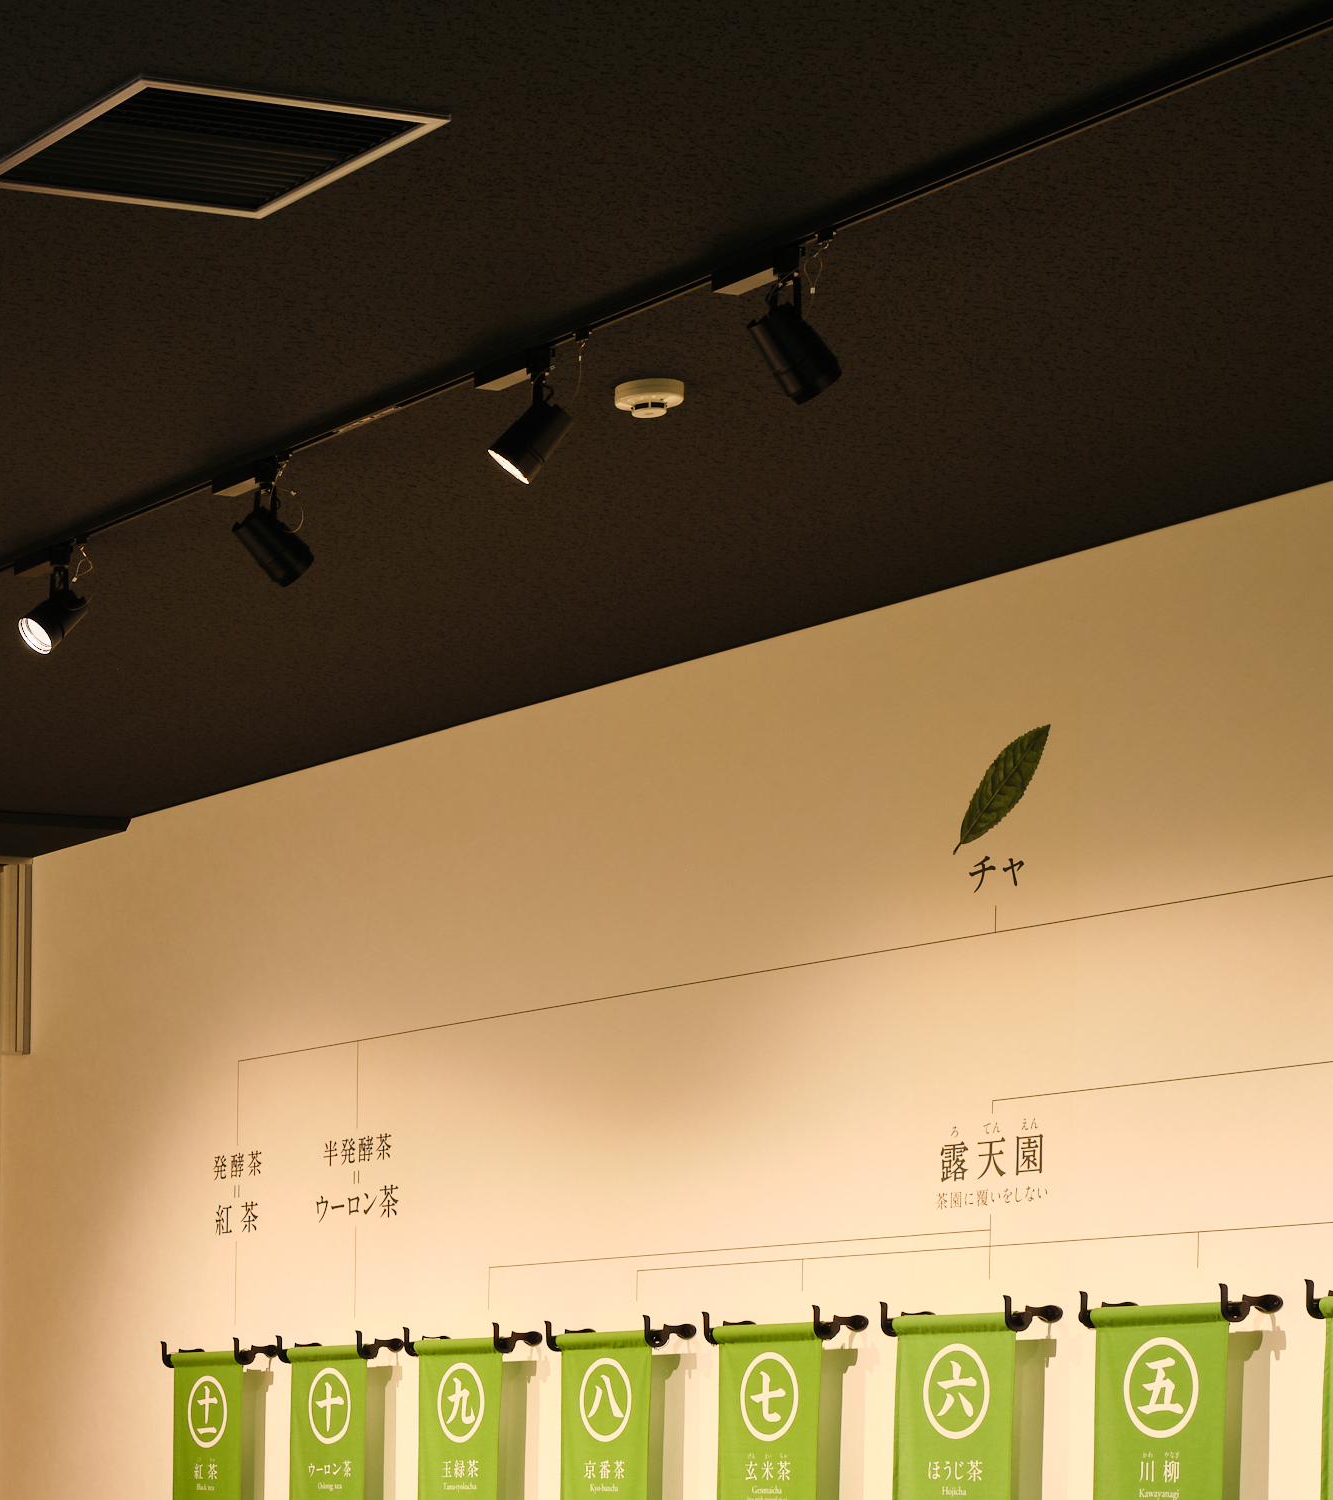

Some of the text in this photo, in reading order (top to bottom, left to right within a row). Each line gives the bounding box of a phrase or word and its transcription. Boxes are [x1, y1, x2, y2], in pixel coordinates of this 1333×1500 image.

[968, 855, 1025, 893] チャ
[983, 1121, 1001, 1135] てん
[1021, 1117, 1040, 1130] えん
[322, 1132, 393, 1168] 半発酵茶
[939, 1132, 1044, 1184] 露天園
[213, 1151, 263, 1182] 発酵茶
[315, 1184, 400, 1223] ウーロン茶
[935, 1184, 1048, 1211] 茶園に覆いをしない
[215, 1201, 259, 1236] 紅茶
[587, 1374, 624, 1418] 八
[750, 1370, 786, 1423] 七
[936, 1360, 977, 1418] 六
[1137, 1356, 1184, 1415] 五
[197, 1385, 218, 1435] 十一
[315, 1381, 345, 1432] 十
[446, 1377, 475, 1425] 九
[194, 1463, 218, 1480] 紅茶
[308, 1460, 352, 1478] ウーロン茶
[441, 1459, 479, 1479] 玉緑茶
[583, 1459, 625, 1480] 京番茶
[745, 1460, 791, 1481] 玄米茶
[928, 1460, 983, 1482] ほうじ茶
[1139, 1460, 1180, 1483] 川柳
[196, 1483, 207, 1491] Black
[589, 1483, 619, 1494] Kyo-bancha
[751, 1485, 782, 1494] Genmaicha
[941, 1486, 967, 1497] Hojicha
[1139, 1488, 1180, 1500] Kawayanagi
